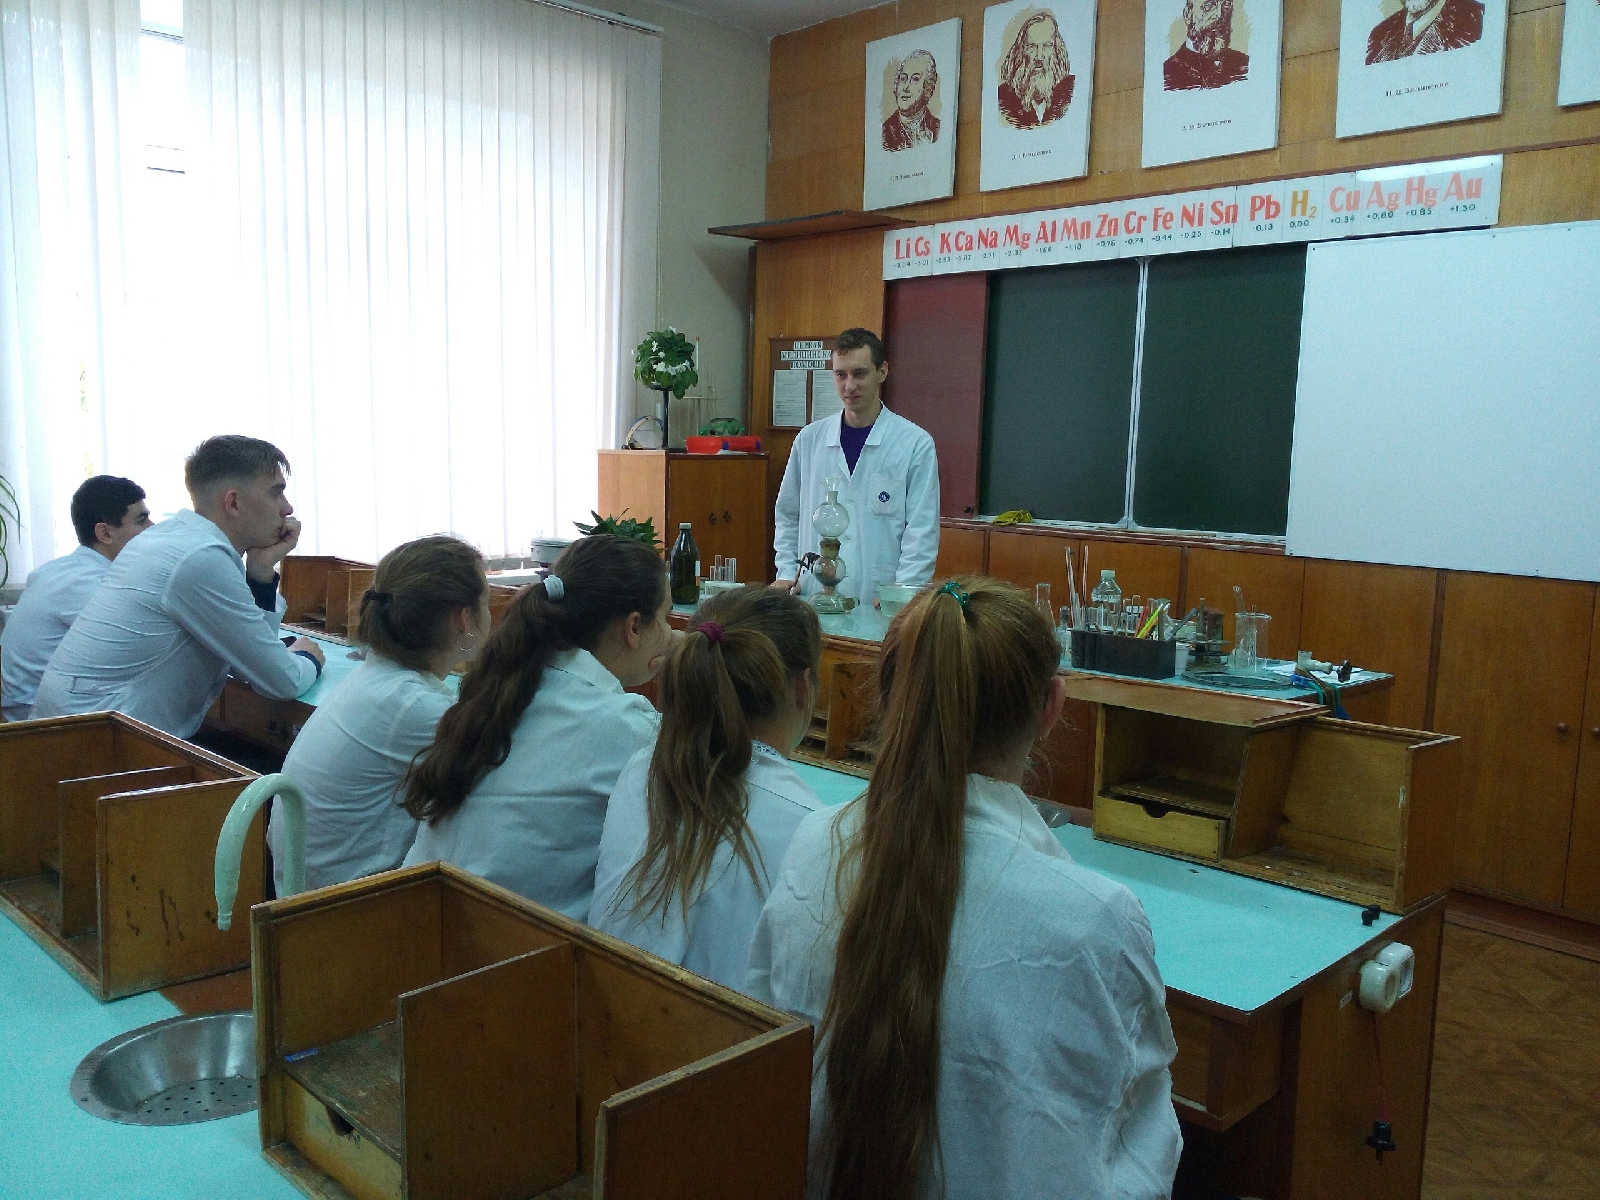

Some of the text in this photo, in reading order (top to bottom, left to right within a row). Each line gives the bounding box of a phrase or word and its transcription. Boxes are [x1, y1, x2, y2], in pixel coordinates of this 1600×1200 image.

[894, 237, 911, 260] Li
[914, 235, 931, 257] Cs
[939, 231, 952, 255] K
[954, 230, 974, 252] Ca
[977, 227, 999, 250] Na
[1002, 223, 1032, 250] Mg
[1035, 219, 1057, 244] Al
[1060, 217, 1092, 242] Mn
[1095, 212, 1119, 239] Zn
[1123, 210, 1148, 235] Cr
[1152, 206, 1175, 232] Fe
[1180, 202, 1205, 229] Ni
[1209, 200, 1239, 226] Sn
[1249, 193, 1281, 222] Pb
[1329, 185, 1361, 213] Cu
[1365, 180, 1401, 212] Ag
[1404, 175, 1439, 208] Hg
[1442, 171, 1483, 202] Au
[781, 350, 832, 360] МЕДИЦИНСКА
